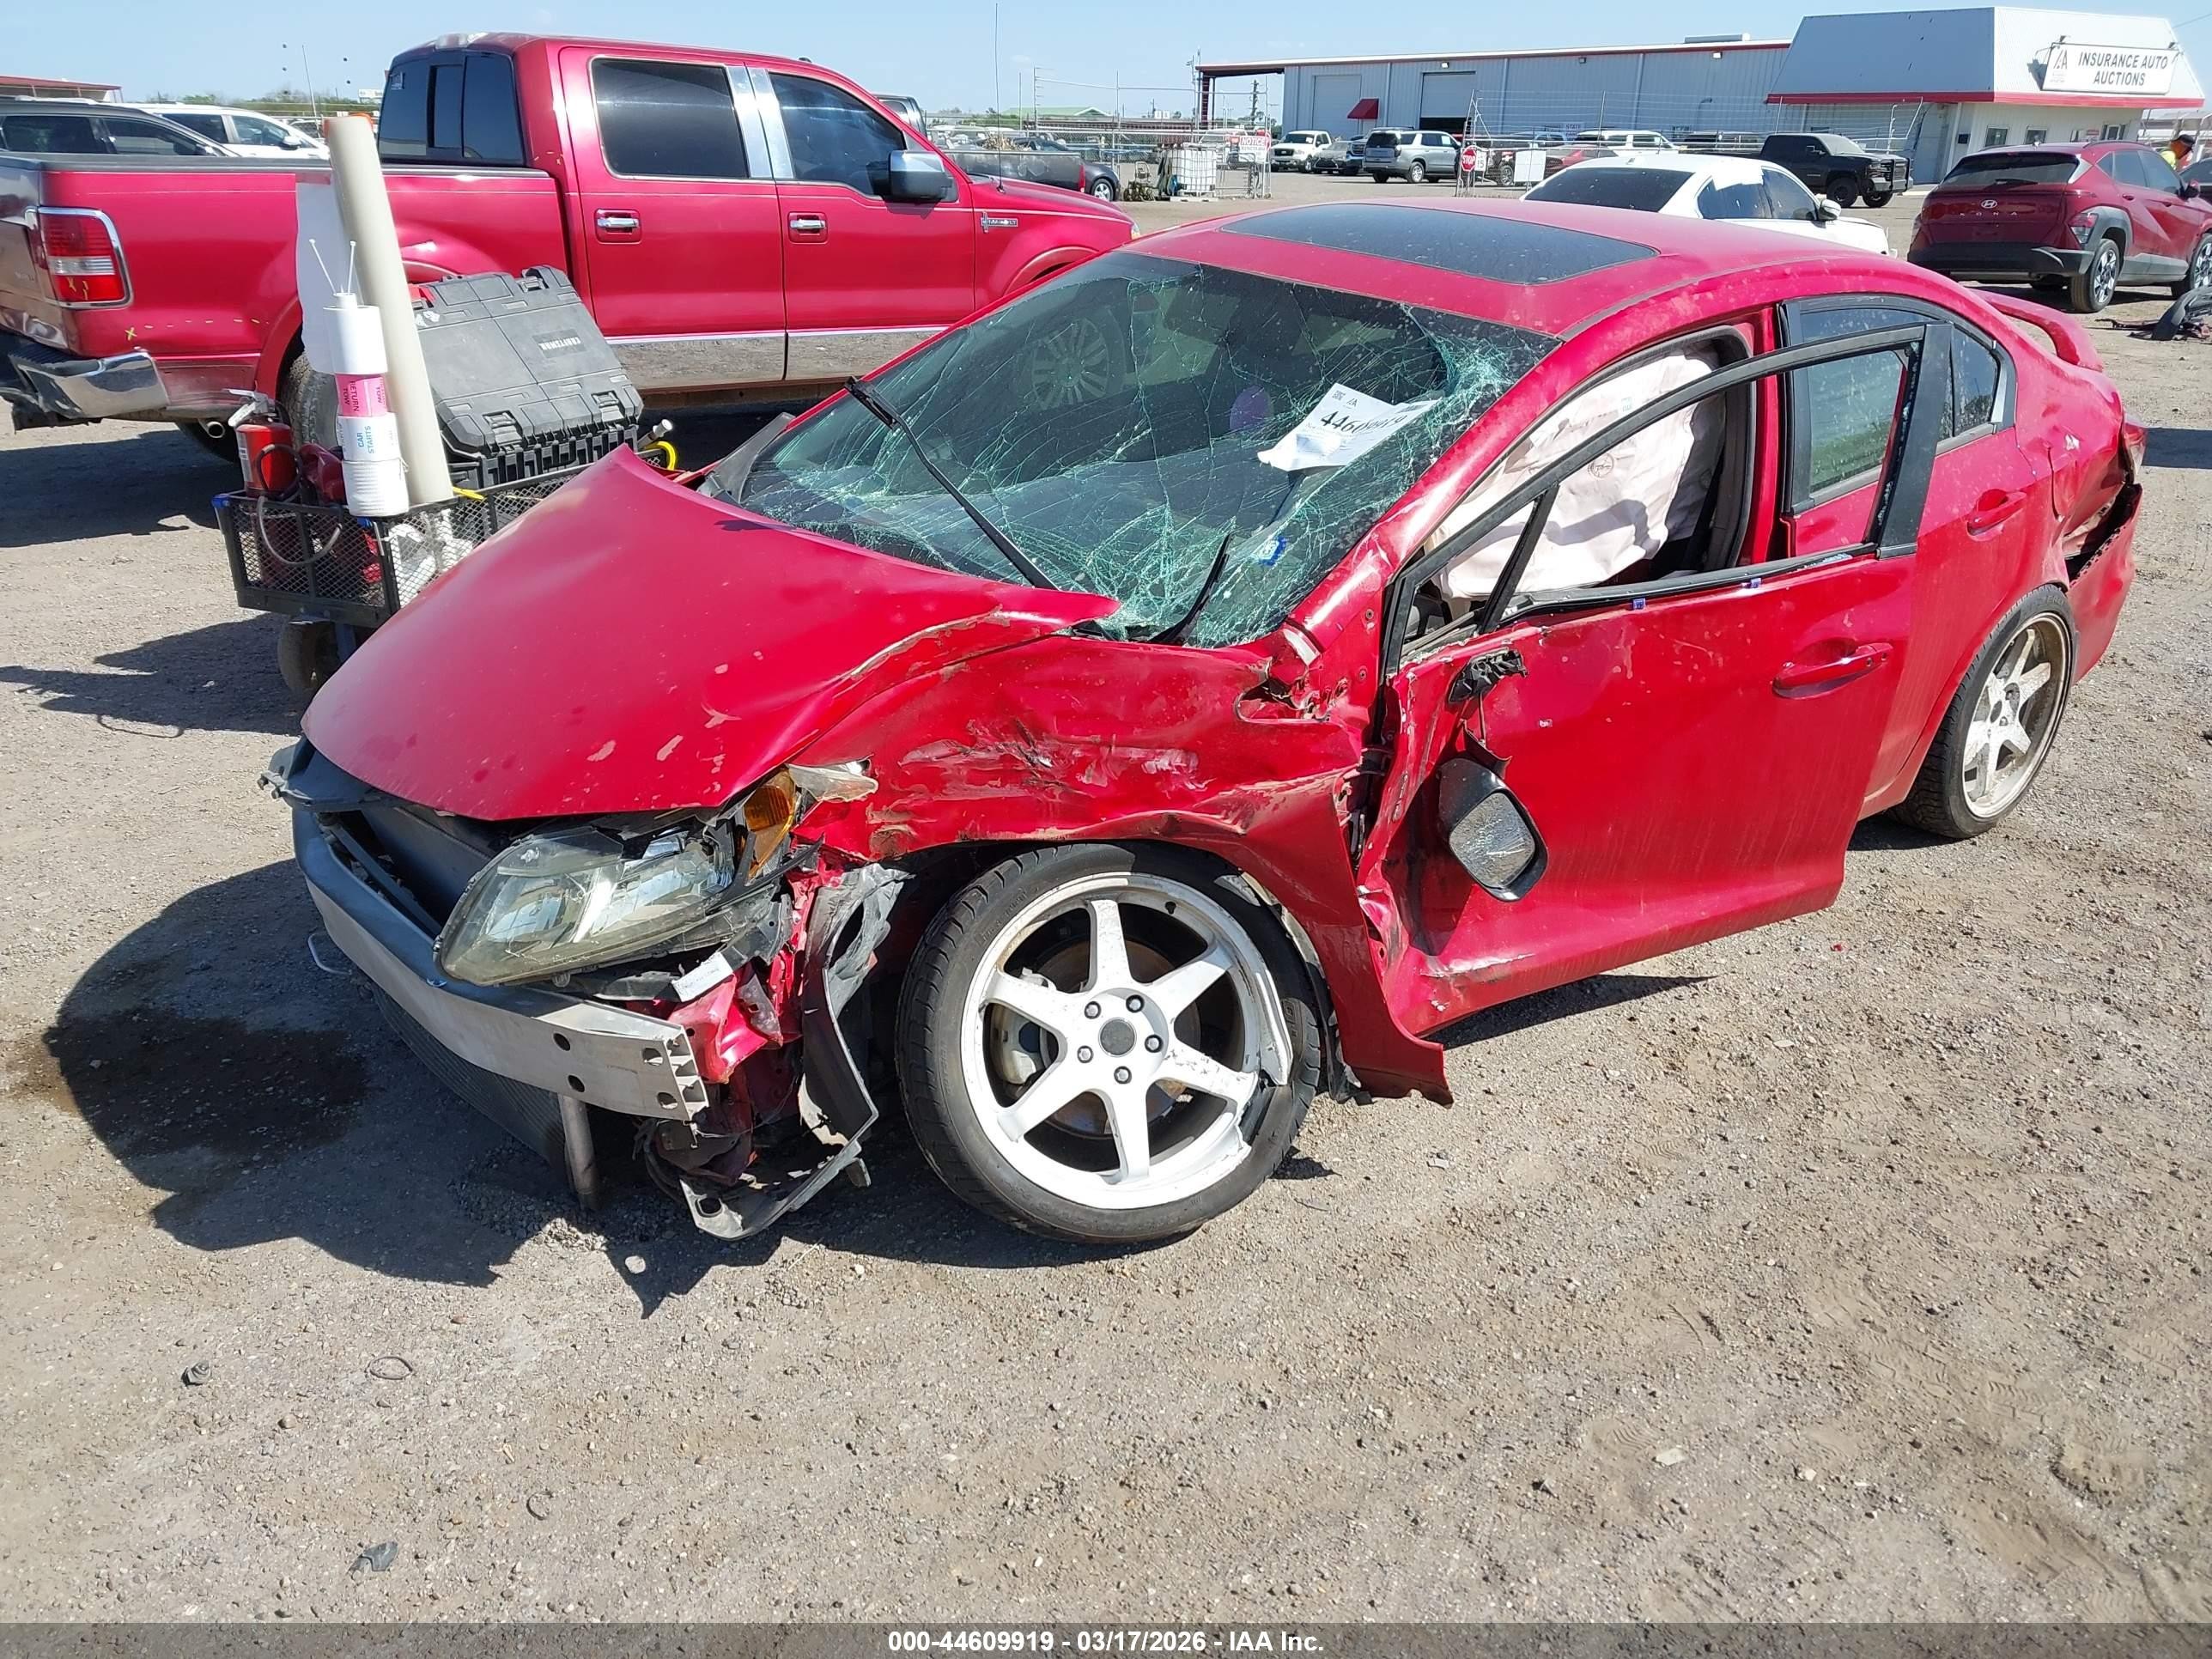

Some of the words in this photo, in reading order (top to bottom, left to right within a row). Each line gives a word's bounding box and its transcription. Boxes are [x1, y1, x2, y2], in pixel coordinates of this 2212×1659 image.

[2078, 52, 2139, 68] INSURANCE
[2141, 55, 2168, 69] AUTO
[2093, 70, 2146, 86] AUCTIONS
[1241, 137, 1265, 146] NOTICE
[1462, 155, 1476, 164] STOP
[349, 380, 360, 412] RETURN
[356, 432, 365, 447] CAR
[364, 425, 374, 454] STARTS
